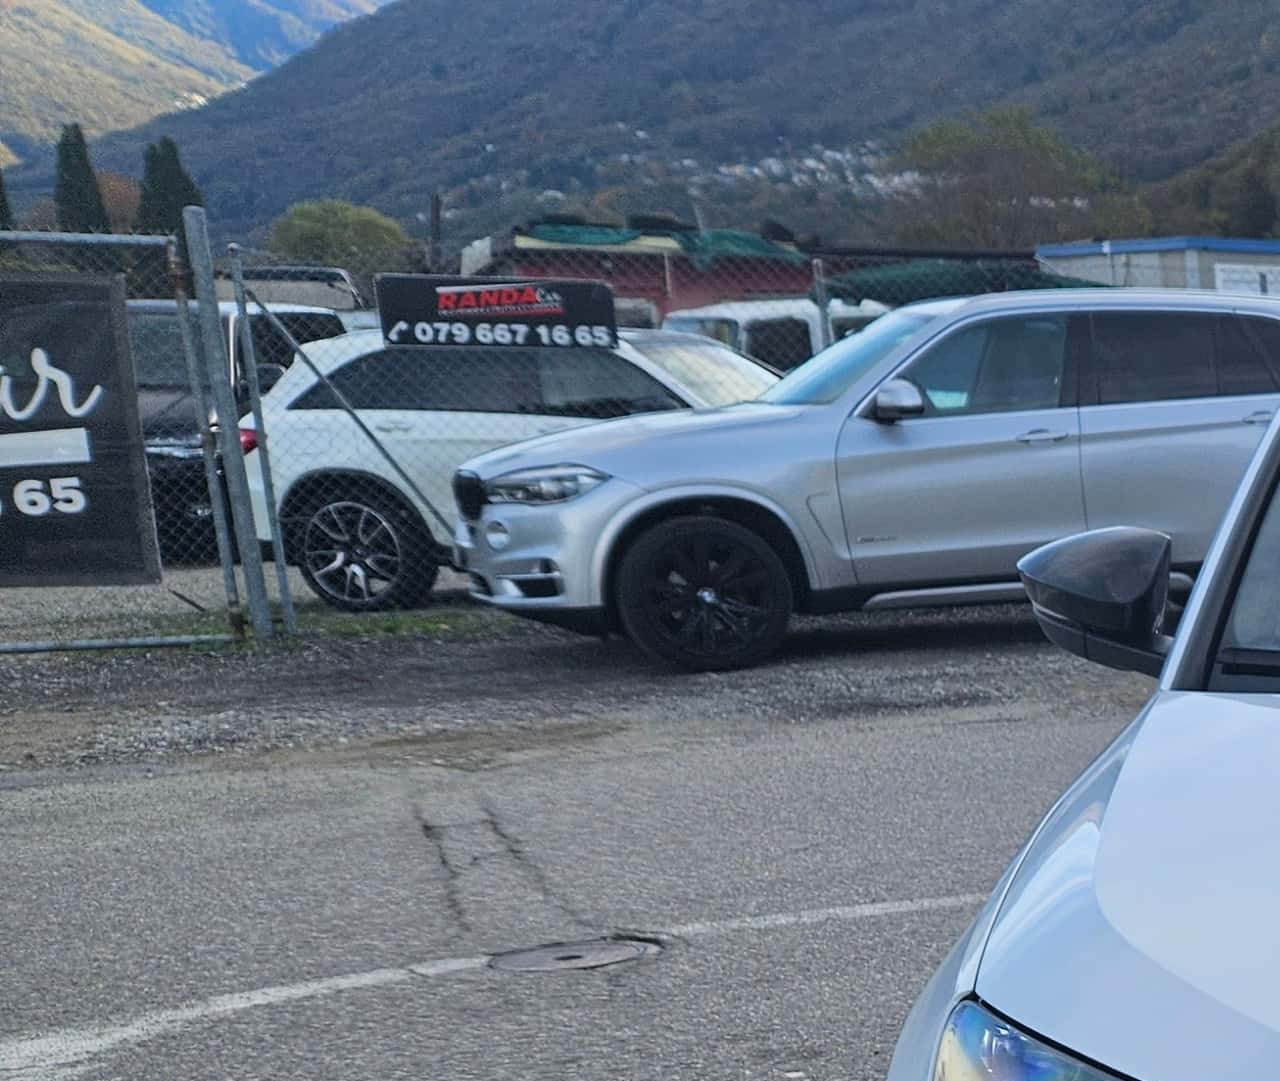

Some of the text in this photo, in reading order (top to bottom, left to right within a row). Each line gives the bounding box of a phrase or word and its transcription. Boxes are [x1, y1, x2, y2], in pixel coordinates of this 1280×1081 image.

[438, 287, 538, 310] RANDA
[414, 321, 612, 347] 079 667 16 65
[13, 476, 87, 516] 65
